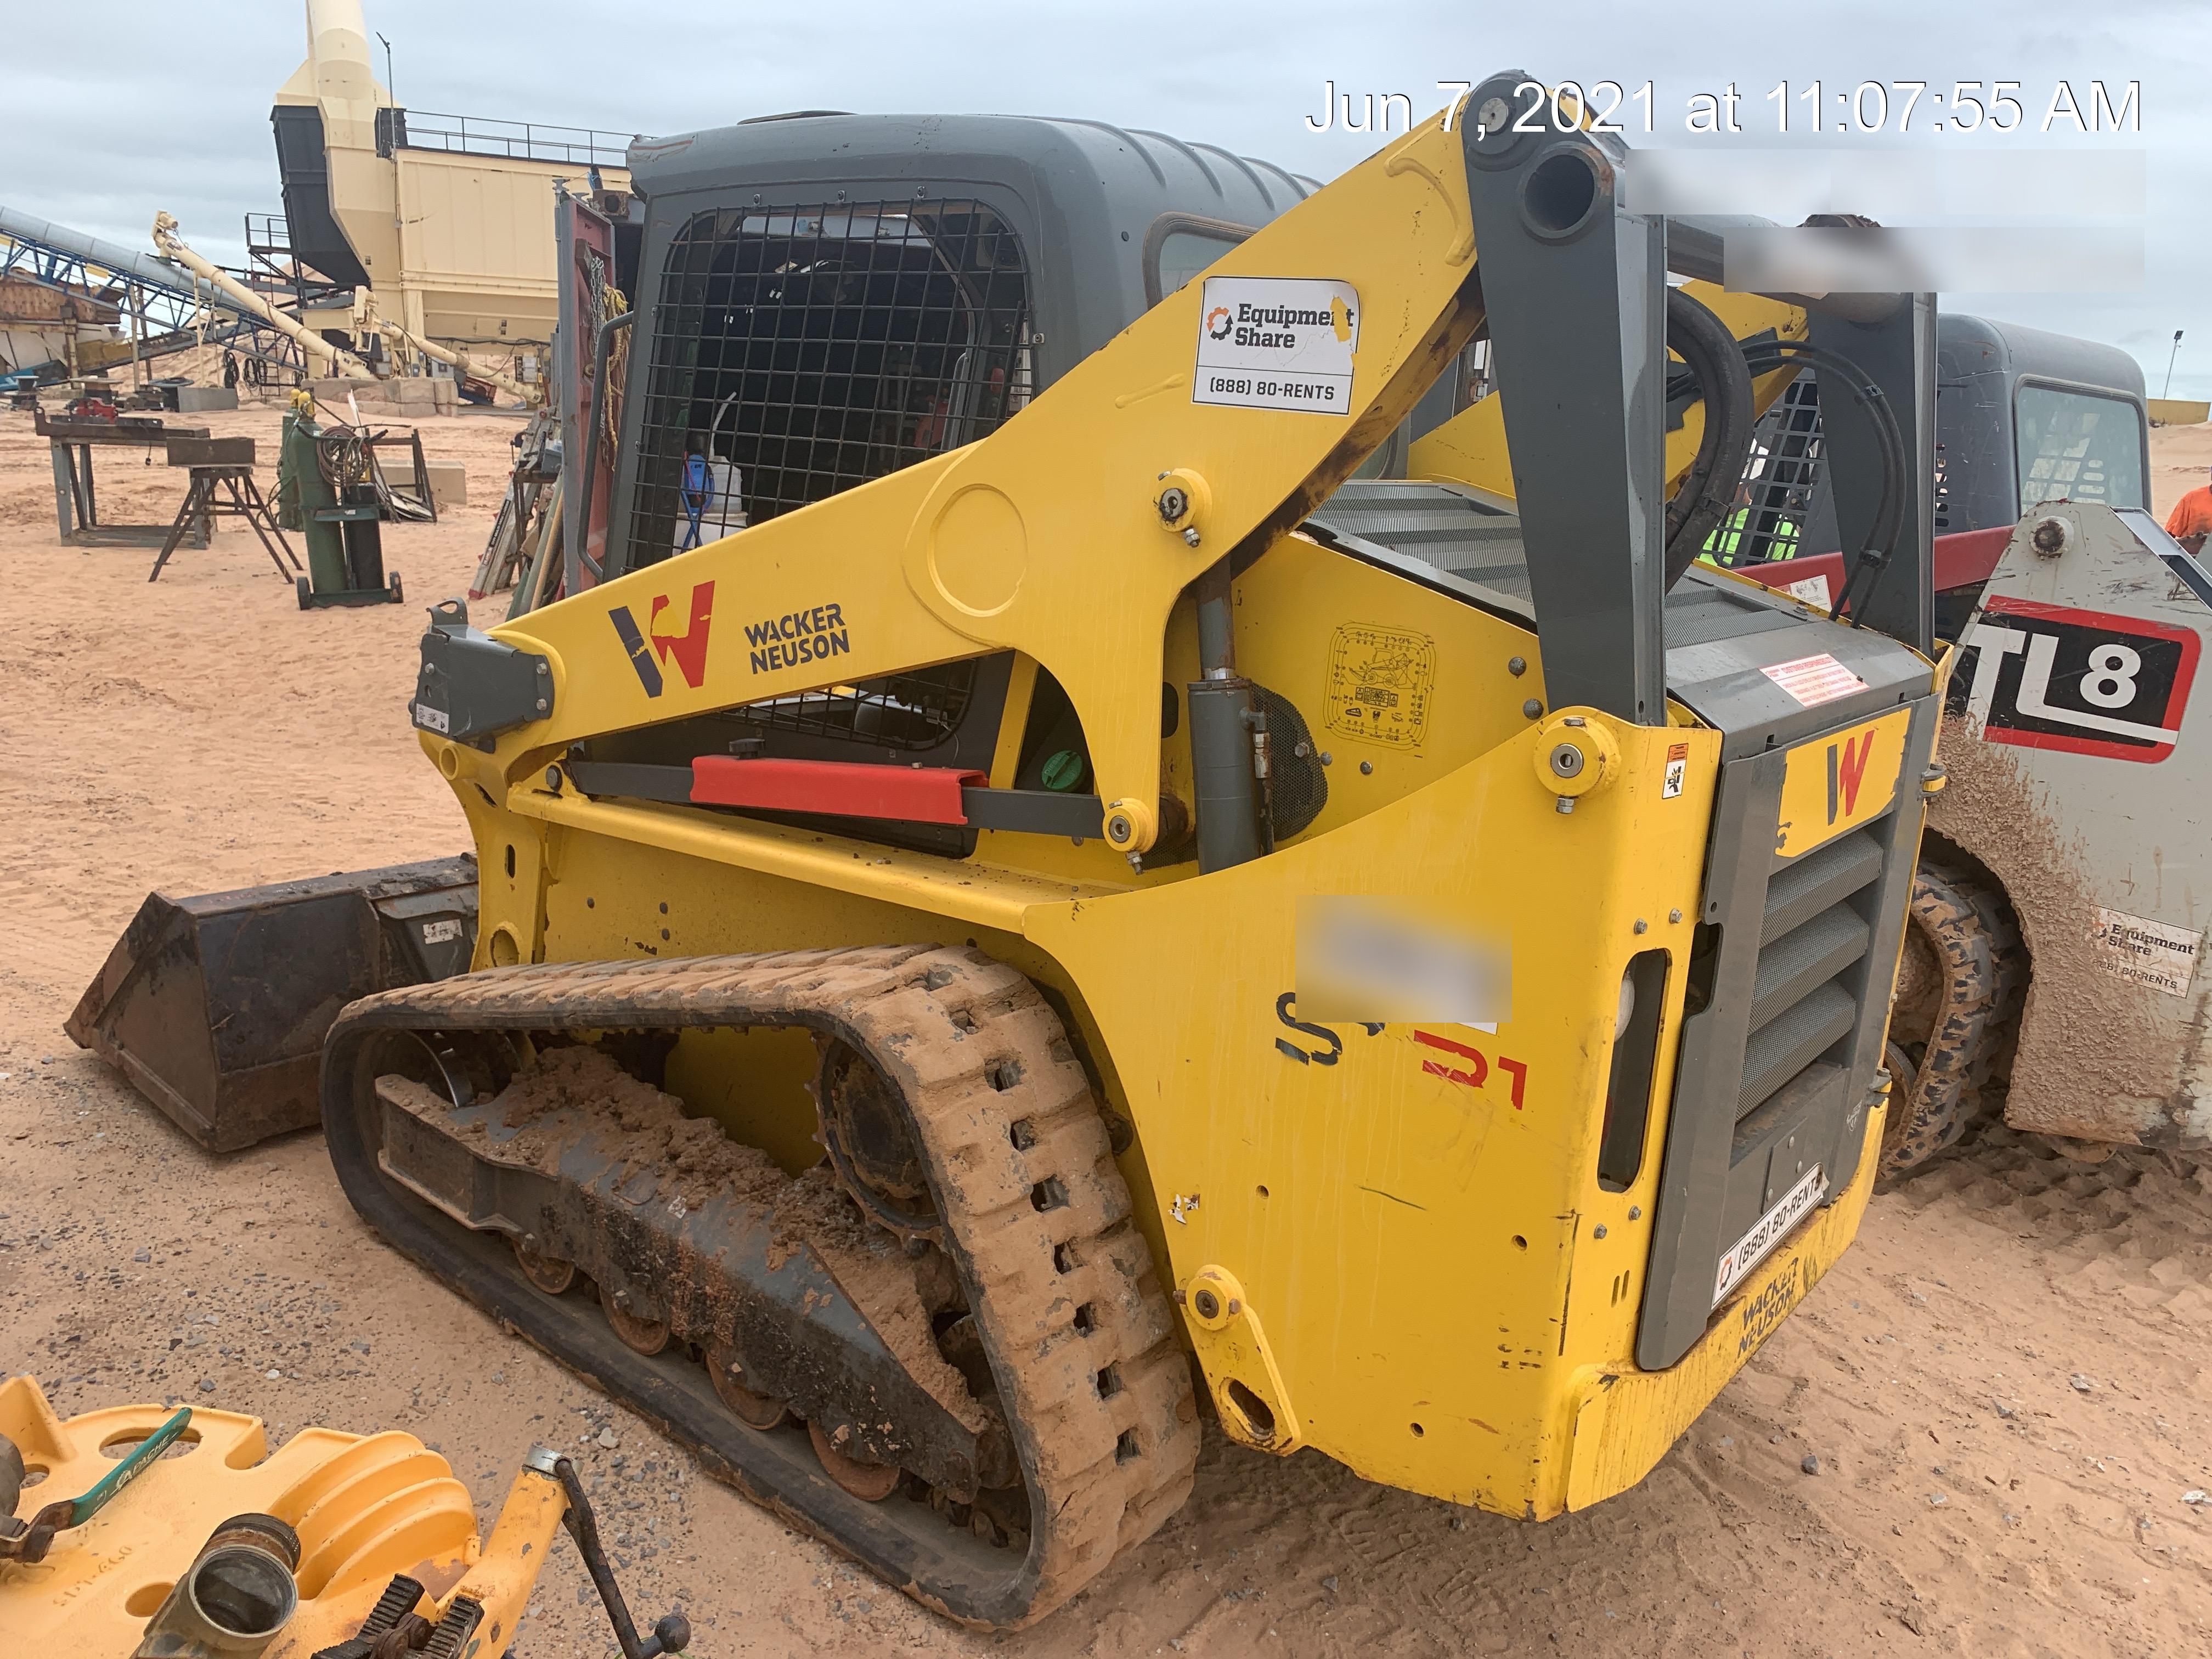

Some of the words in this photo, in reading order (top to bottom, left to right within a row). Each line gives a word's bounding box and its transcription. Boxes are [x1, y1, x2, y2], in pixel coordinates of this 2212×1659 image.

[1234, 326, 1295, 349] Share
[1237, 303, 1355, 329] Equipmet
[1210, 376, 1251, 396] (888)
[1256, 381, 1334, 400] 80-RENTS
[743, 603, 847, 648] WACKER
[749, 629, 851, 675] NEUSON
[1966, 623, 2179, 745] TL8
[1737, 1221, 1770, 1271] (888)
[1771, 1171, 1822, 1234] 80-RENTS
